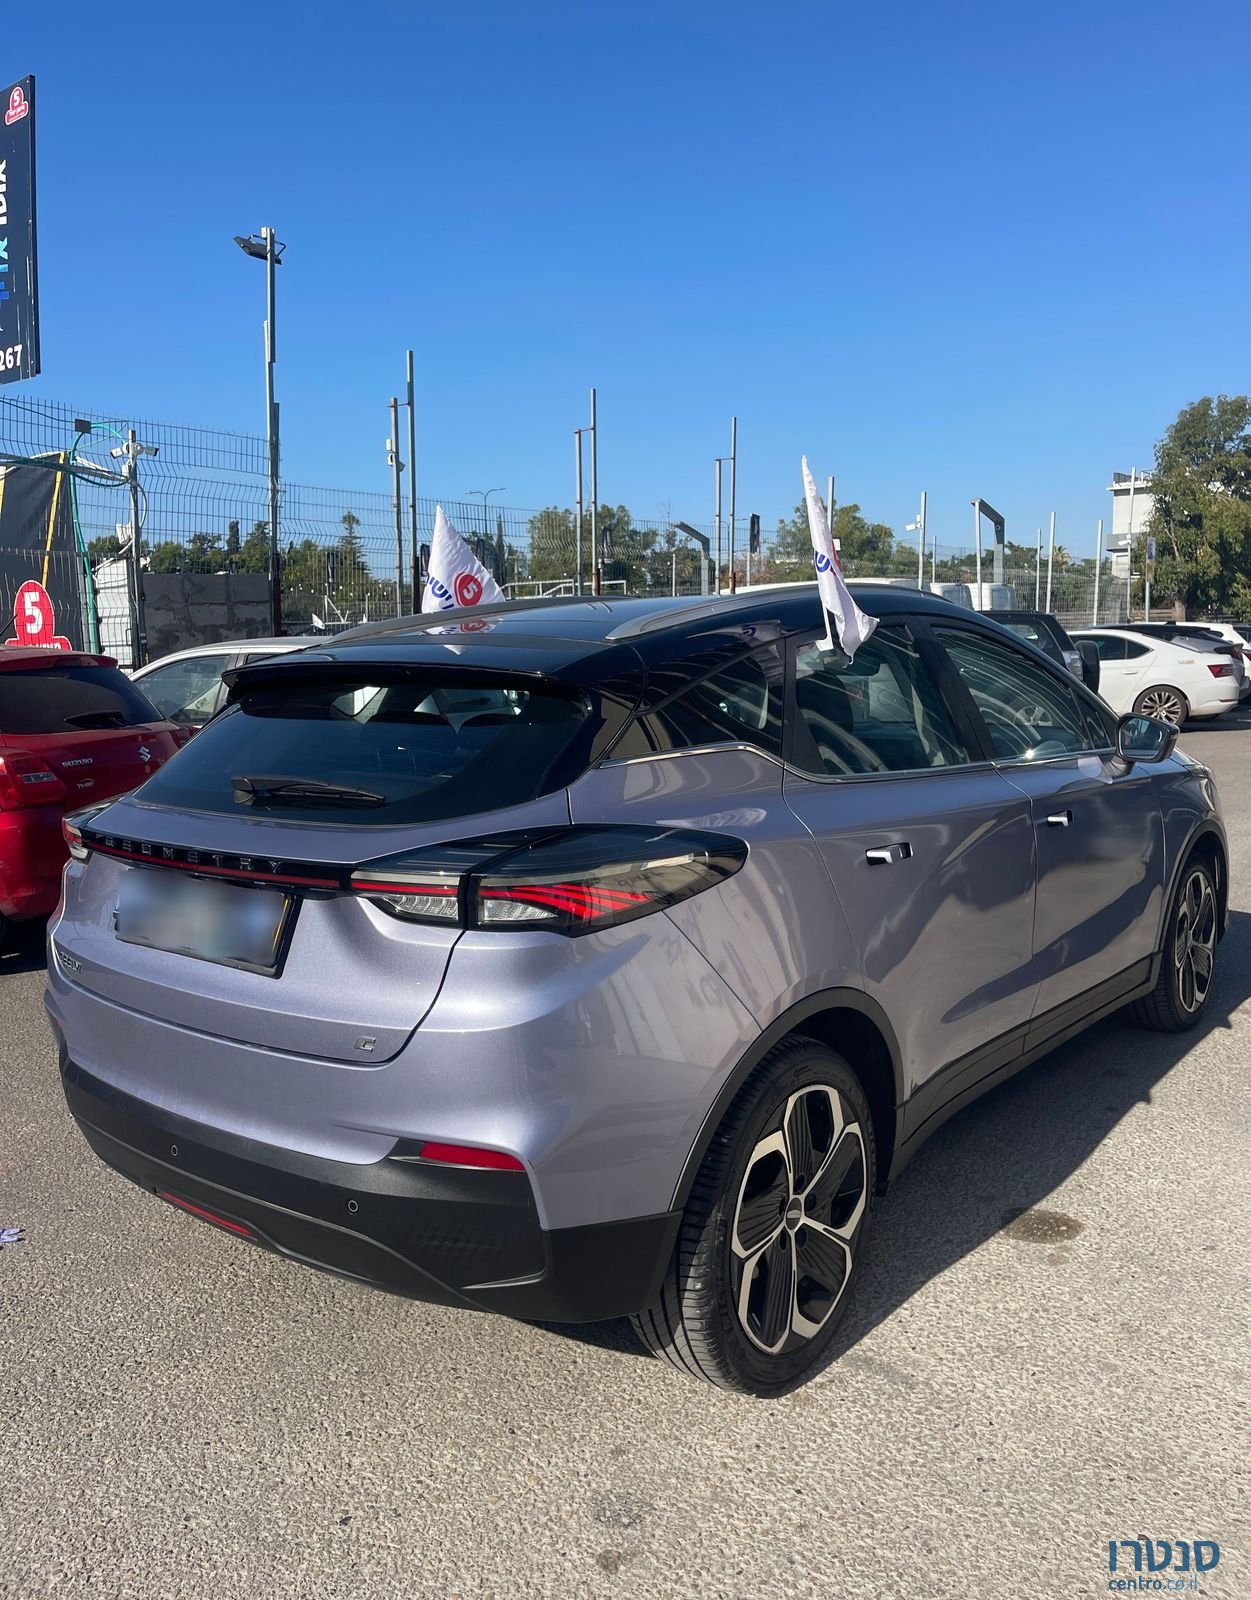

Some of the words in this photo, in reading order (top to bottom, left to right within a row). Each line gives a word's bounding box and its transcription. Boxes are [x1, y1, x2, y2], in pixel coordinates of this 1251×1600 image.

[462, 581, 478, 600] 5
[24, 591, 43, 635] 5
[62, 757, 93, 768] SUZUKI
[105, 836, 282, 874] GEOMETRY
